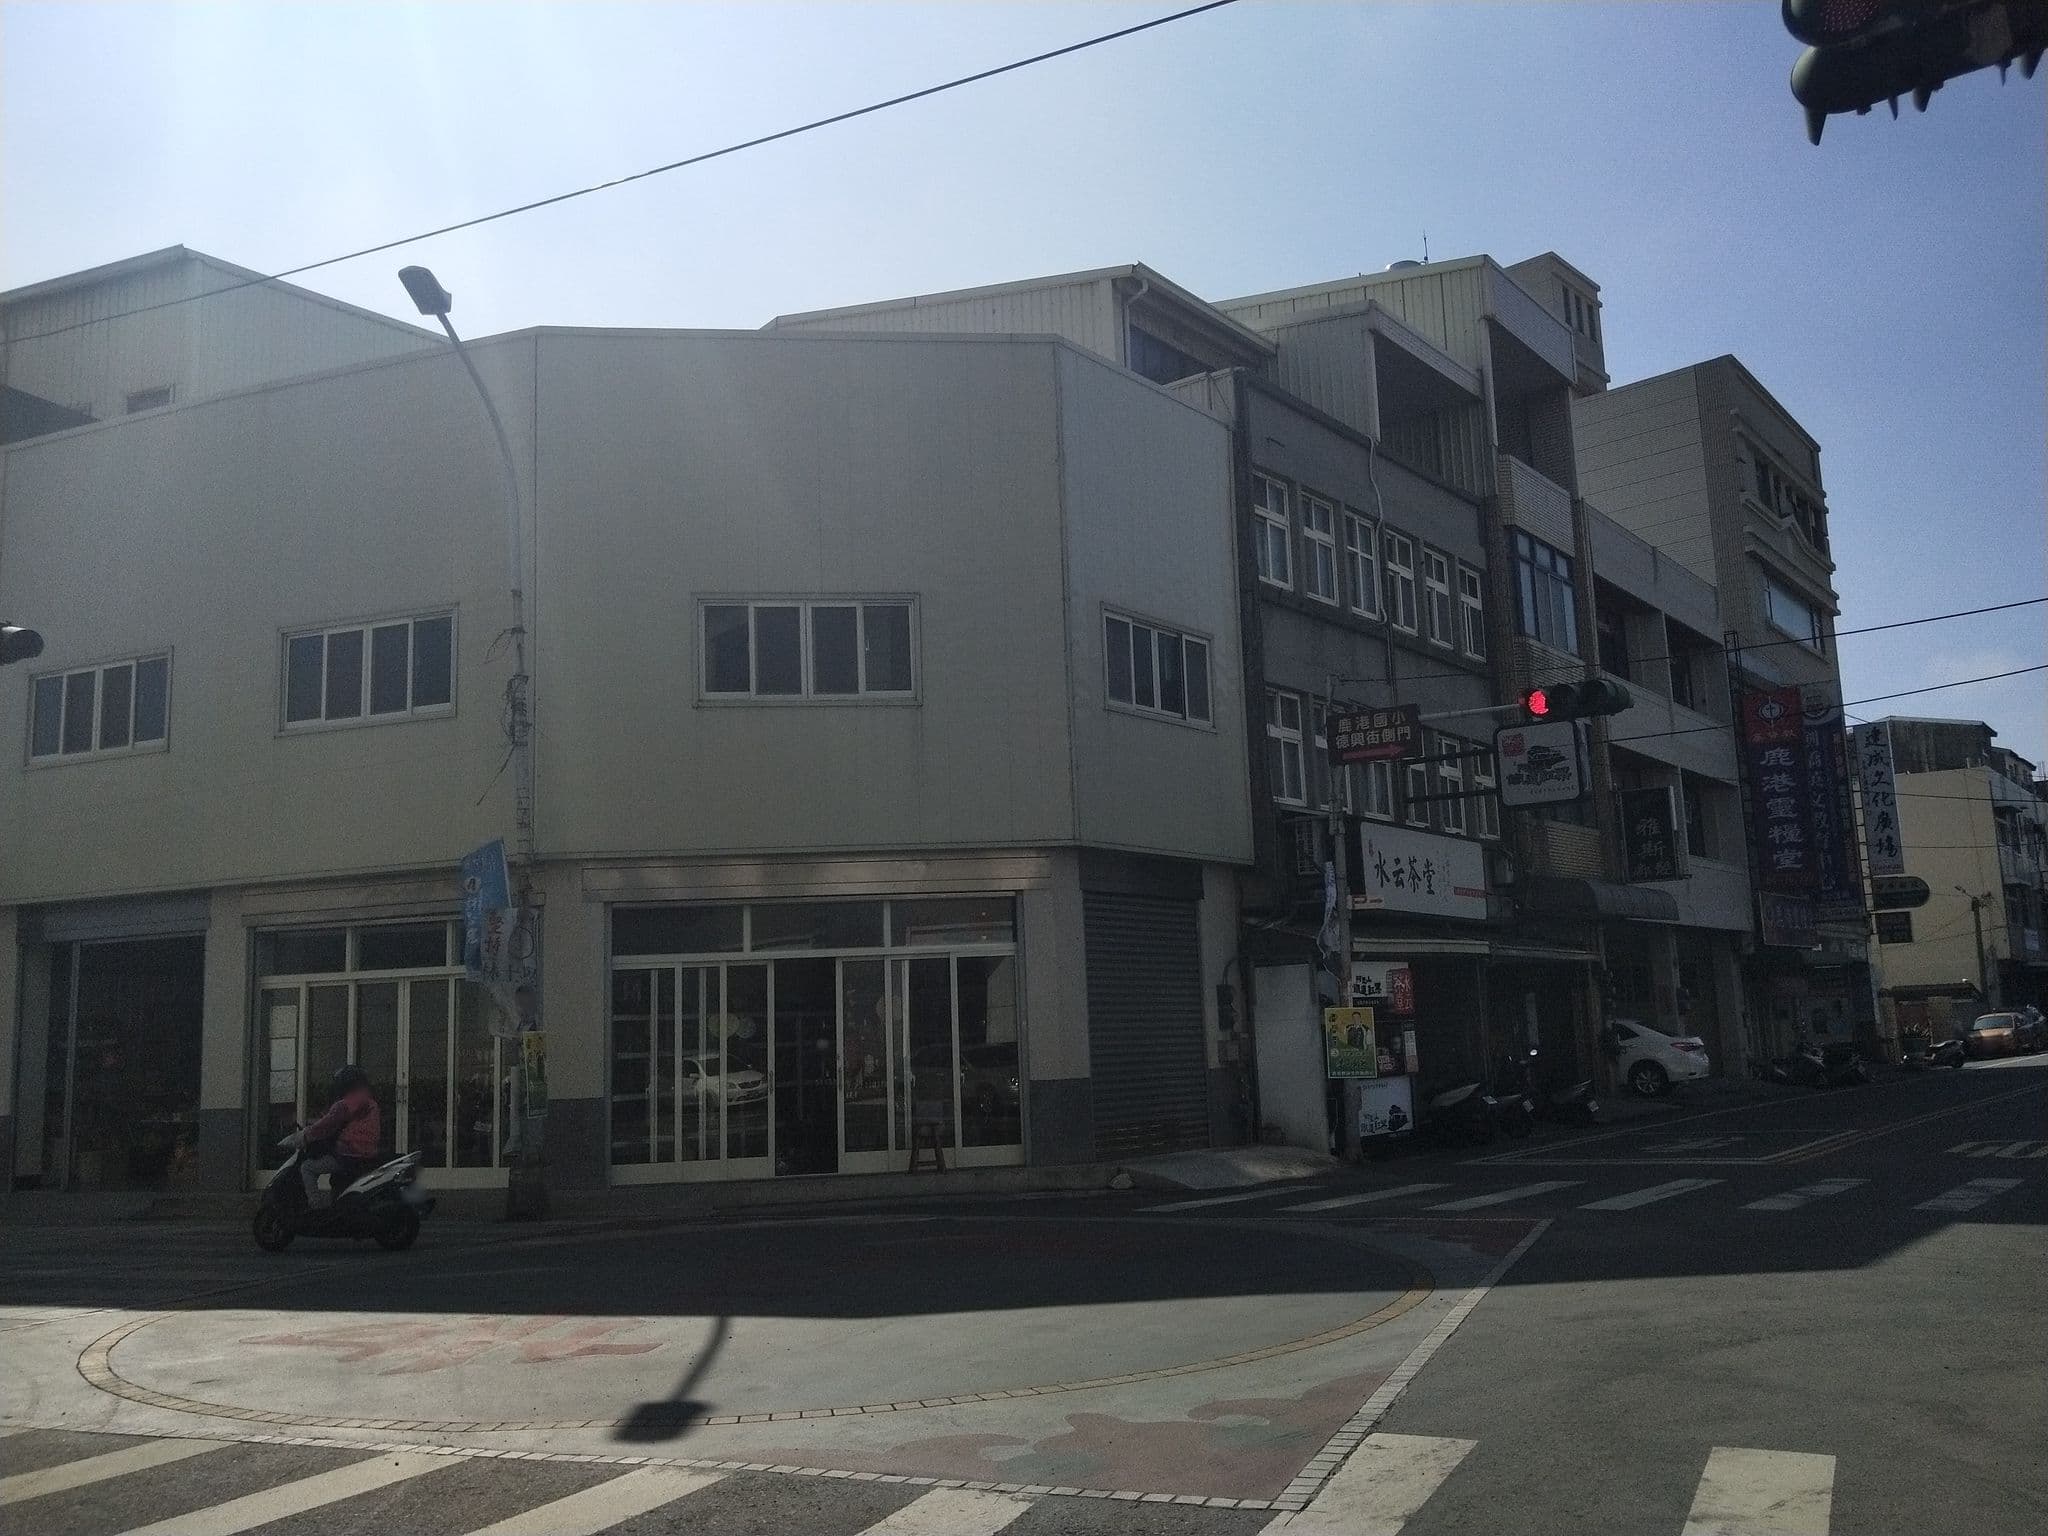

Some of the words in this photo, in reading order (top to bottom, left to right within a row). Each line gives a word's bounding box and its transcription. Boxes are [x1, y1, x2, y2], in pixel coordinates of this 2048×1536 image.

[1338, 711, 1406, 733] 鹿港國小
[1335, 725, 1411, 749] 德興街側門
[1374, 850, 1436, 896] 水云茶堂
